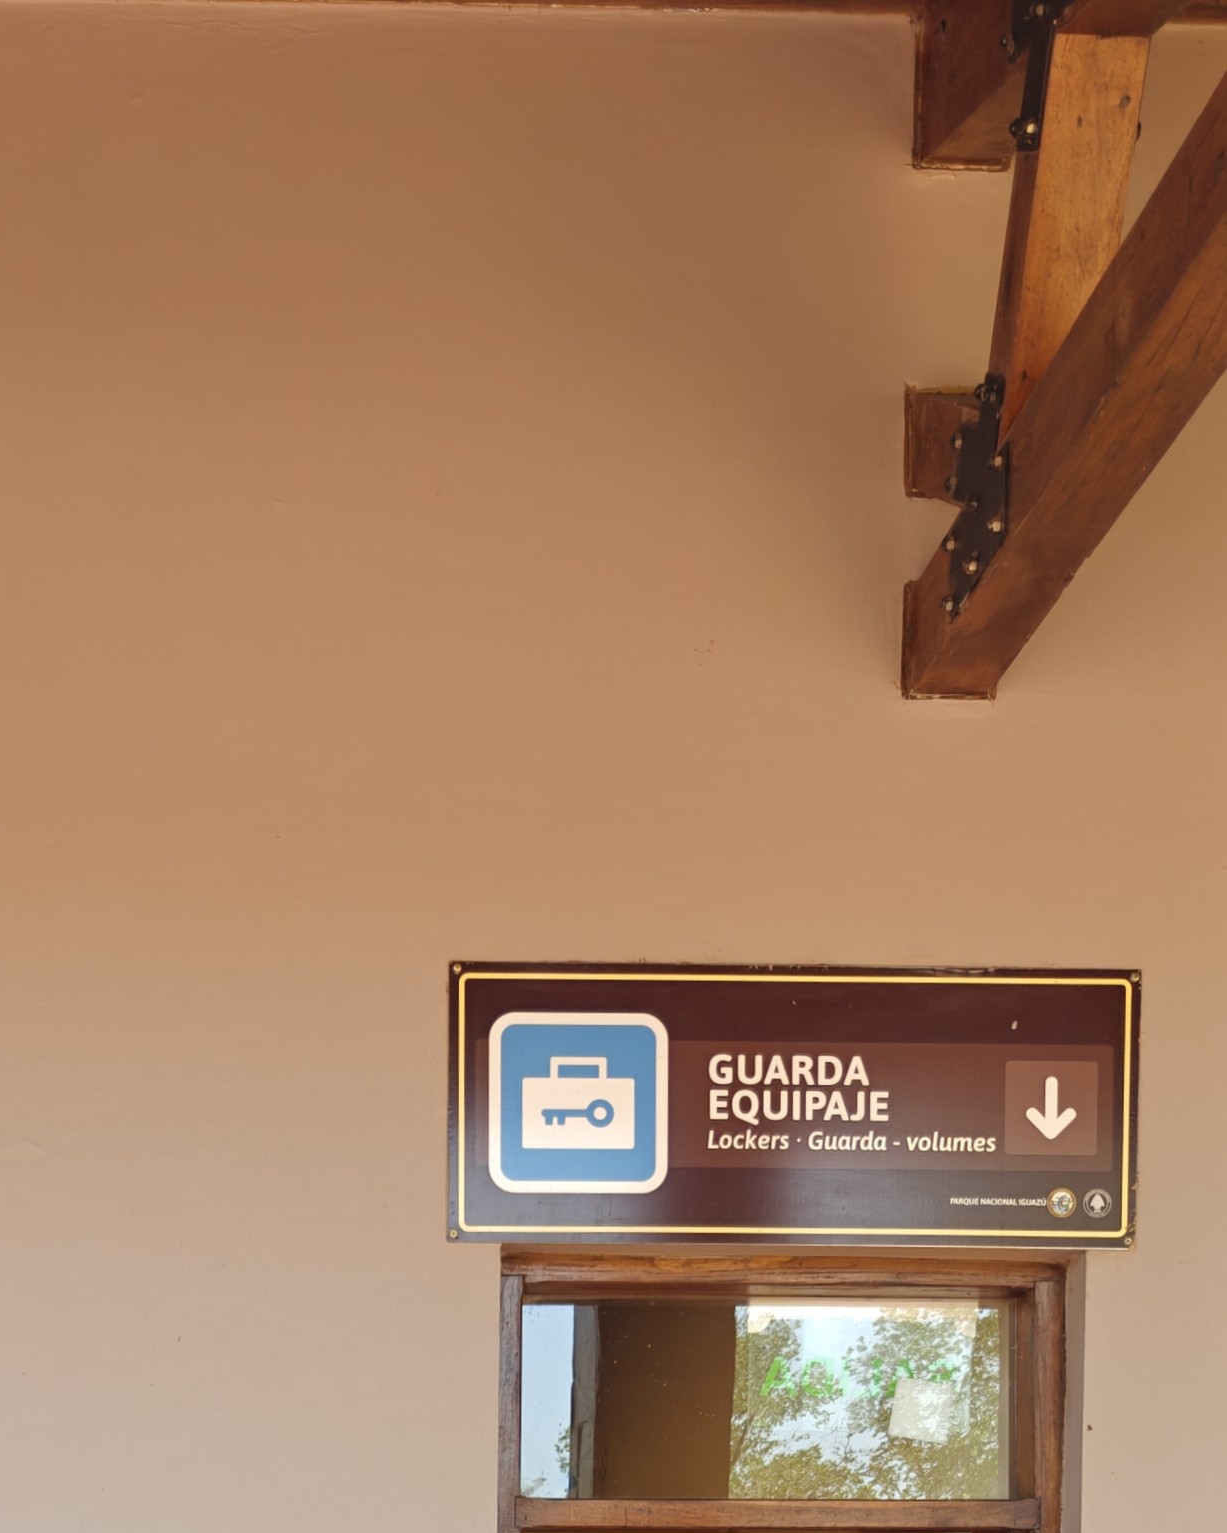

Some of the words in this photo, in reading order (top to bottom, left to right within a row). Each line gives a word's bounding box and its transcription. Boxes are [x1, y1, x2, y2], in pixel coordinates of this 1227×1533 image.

[708, 1054, 870, 1086] GUARDA
[709, 1089, 890, 1125] EQUIPAJE
[707, 1129, 790, 1150] Lockers
[807, 1131, 888, 1151] Guarda
[906, 1131, 997, 1152] volumes
[950, 1197, 979, 1206] PARQUE
[980, 1197, 1018, 1207] NACIONAL
[1018, 1196, 1047, 1207] IGUAZÚ
